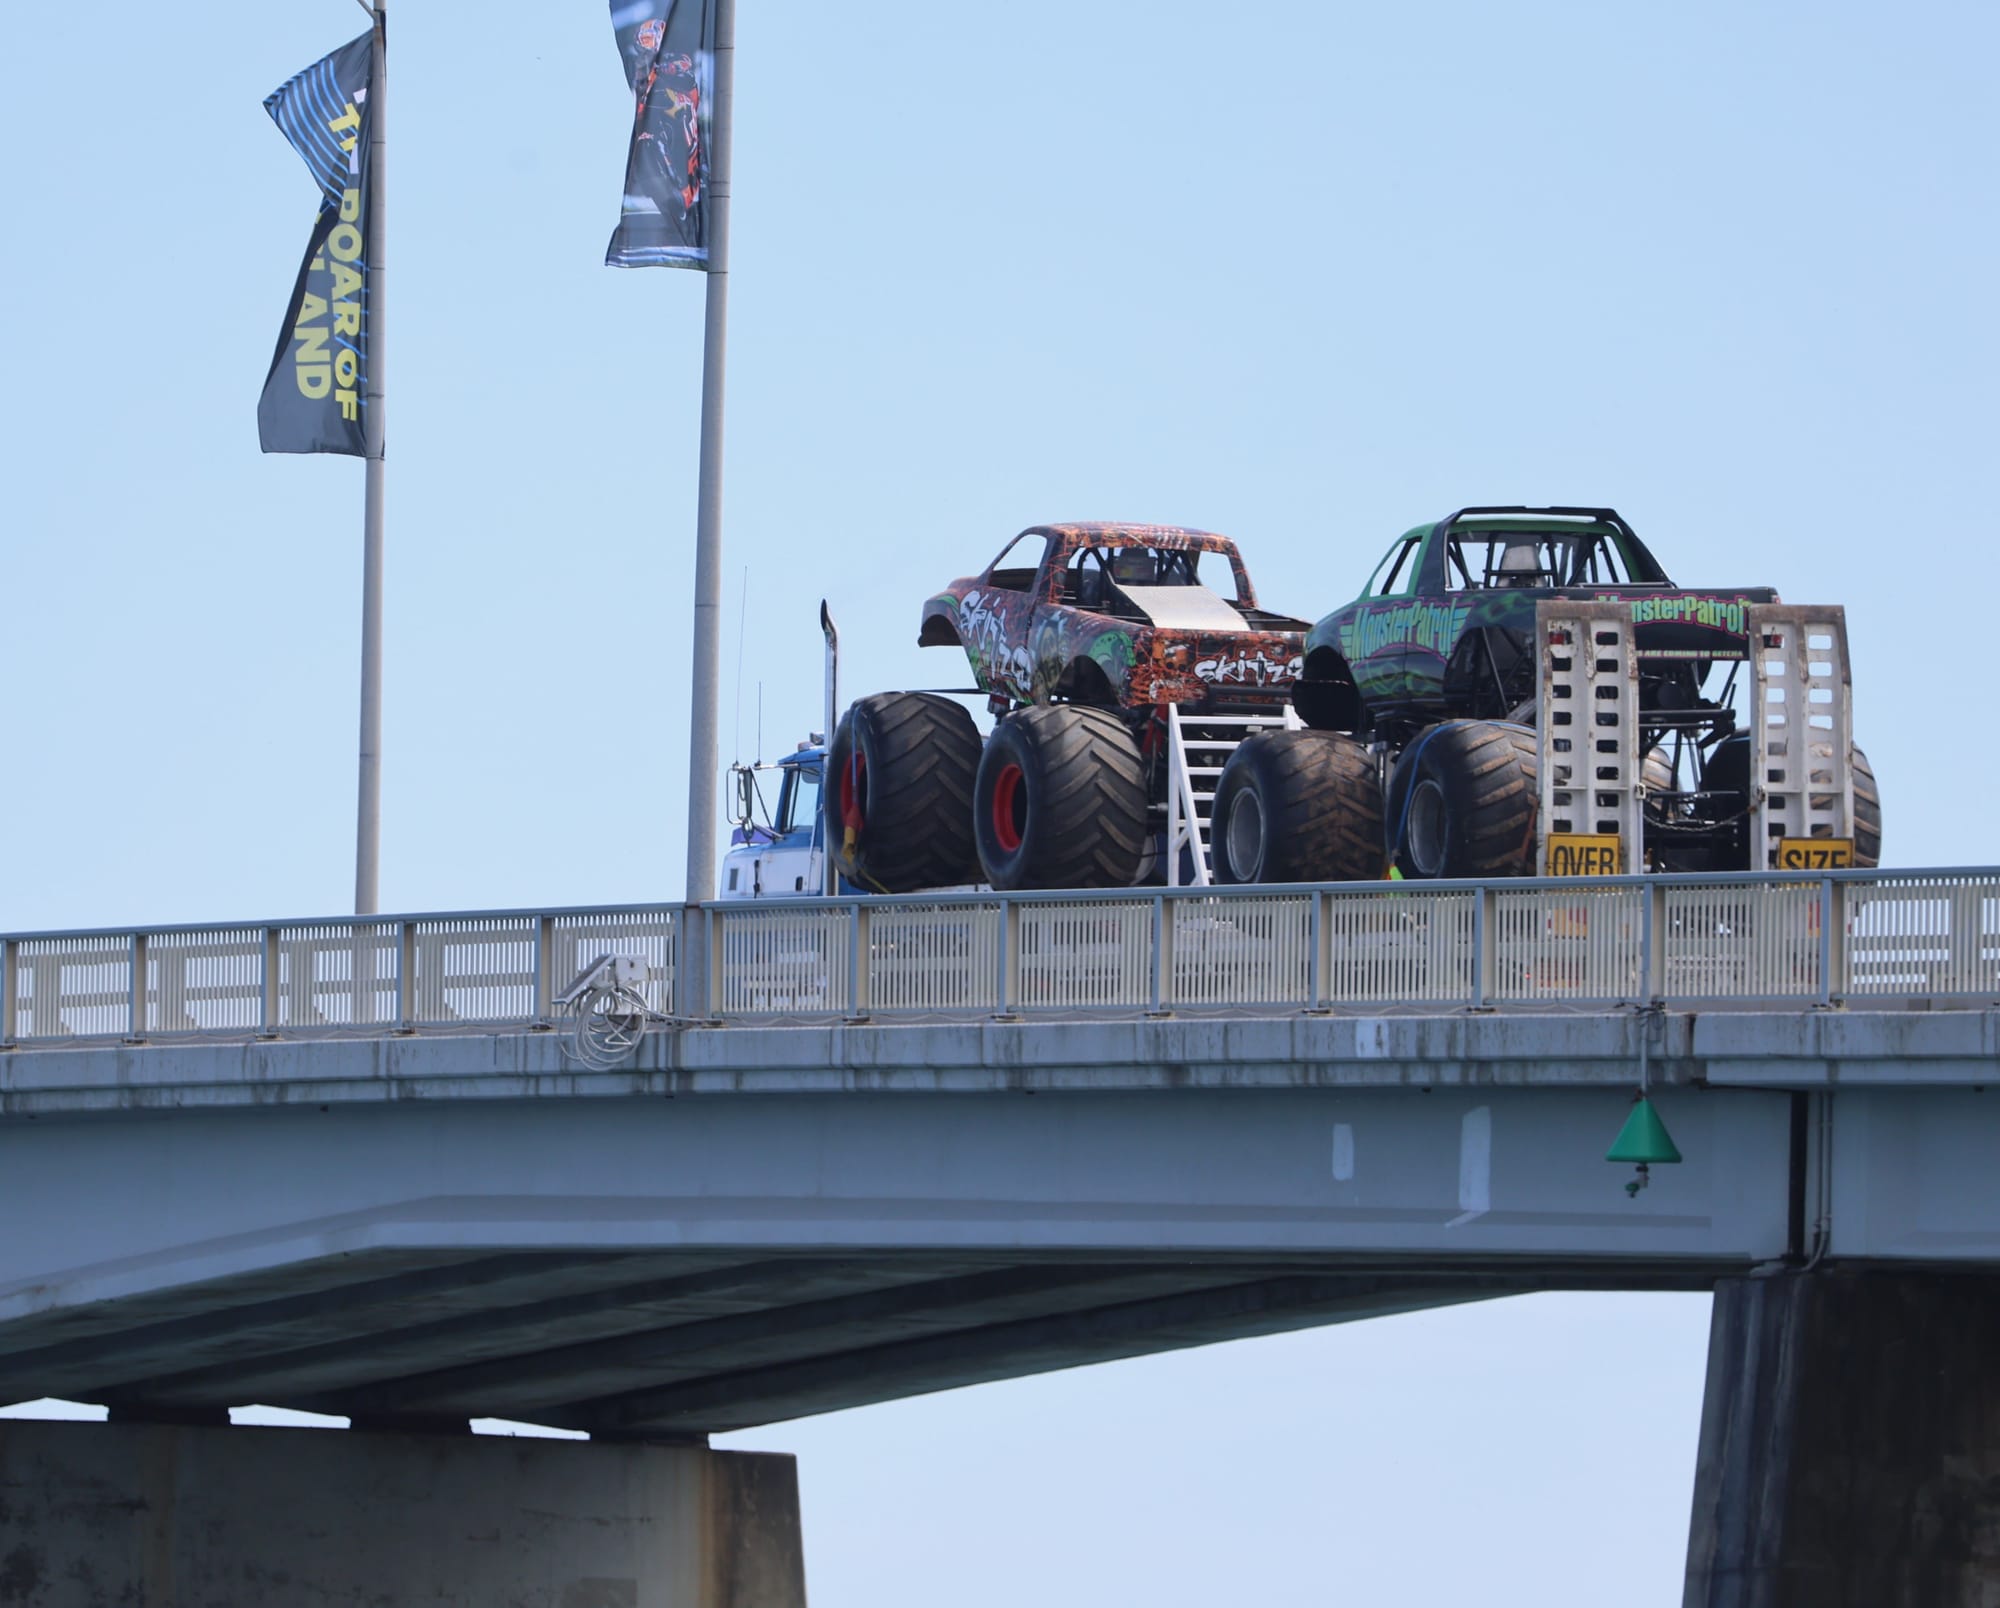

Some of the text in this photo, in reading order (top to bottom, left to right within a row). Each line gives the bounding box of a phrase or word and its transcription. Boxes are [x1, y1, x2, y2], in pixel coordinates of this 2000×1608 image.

[327, 188, 362, 421] ROAR OF
[1553, 845, 1614, 876] OVER
[1786, 849, 1846, 870] SIZE
